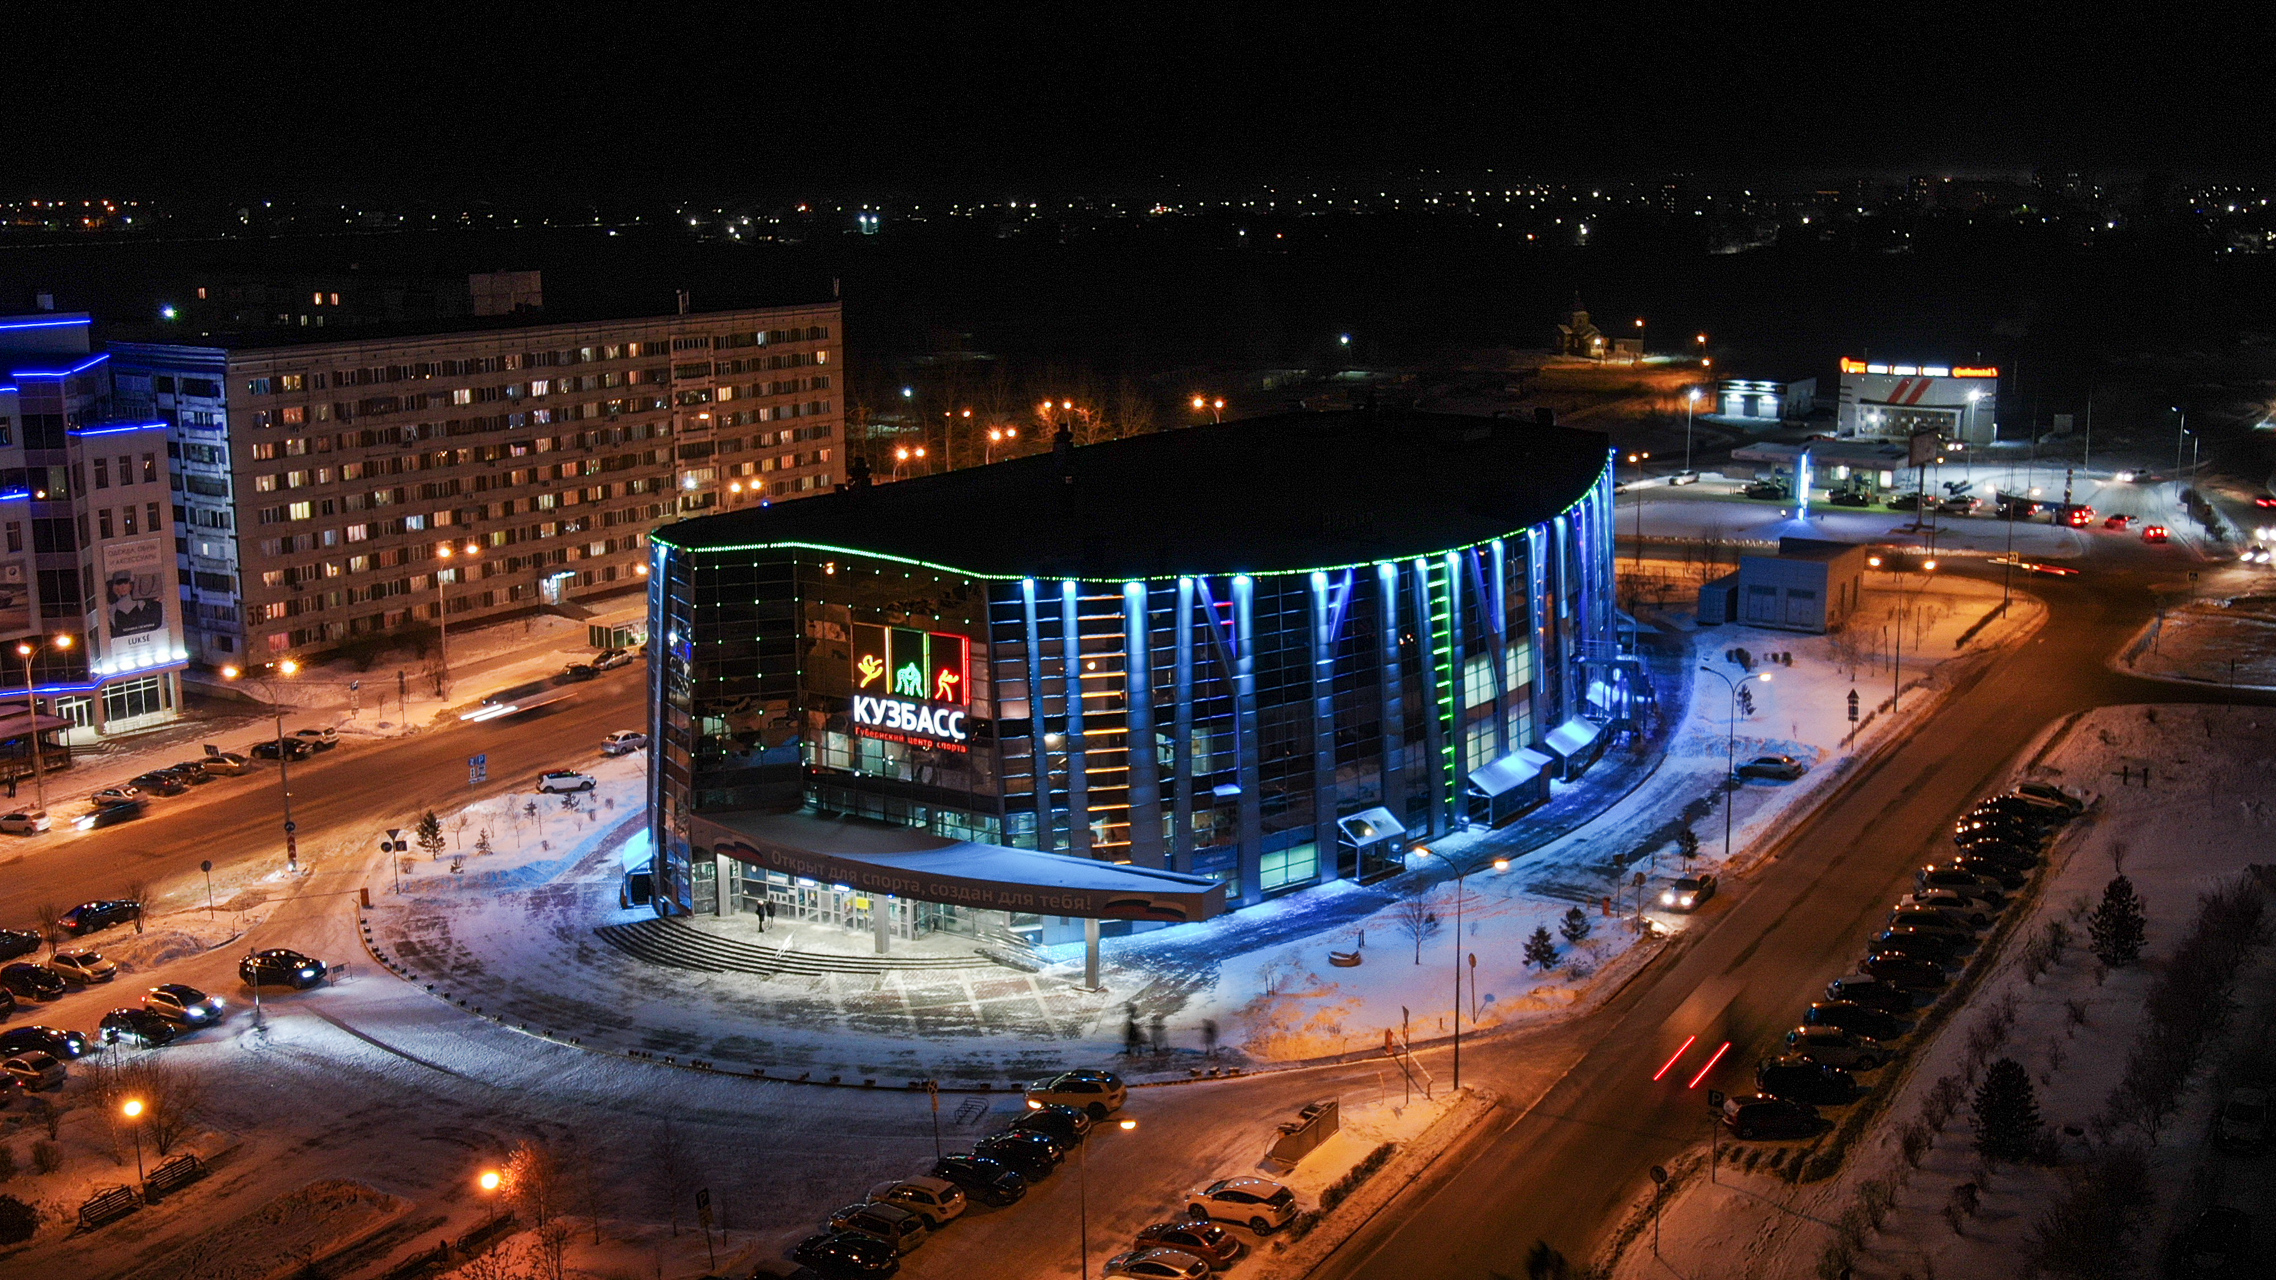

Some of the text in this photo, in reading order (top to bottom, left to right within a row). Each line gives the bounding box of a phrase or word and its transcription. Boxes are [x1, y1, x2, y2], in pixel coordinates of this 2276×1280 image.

[247, 604, 264, 627] 56
[853, 695, 966, 740] КУЗБАСС
[855, 726, 968, 754] Губернский центр спорта
[772, 851, 825, 876] Открыт
[828, 866, 857, 882] для
[863, 872, 925, 896] спорта,
[930, 883, 993, 902] создан
[998, 890, 1034, 907] для
[1039, 894, 1091, 911] тебя!
